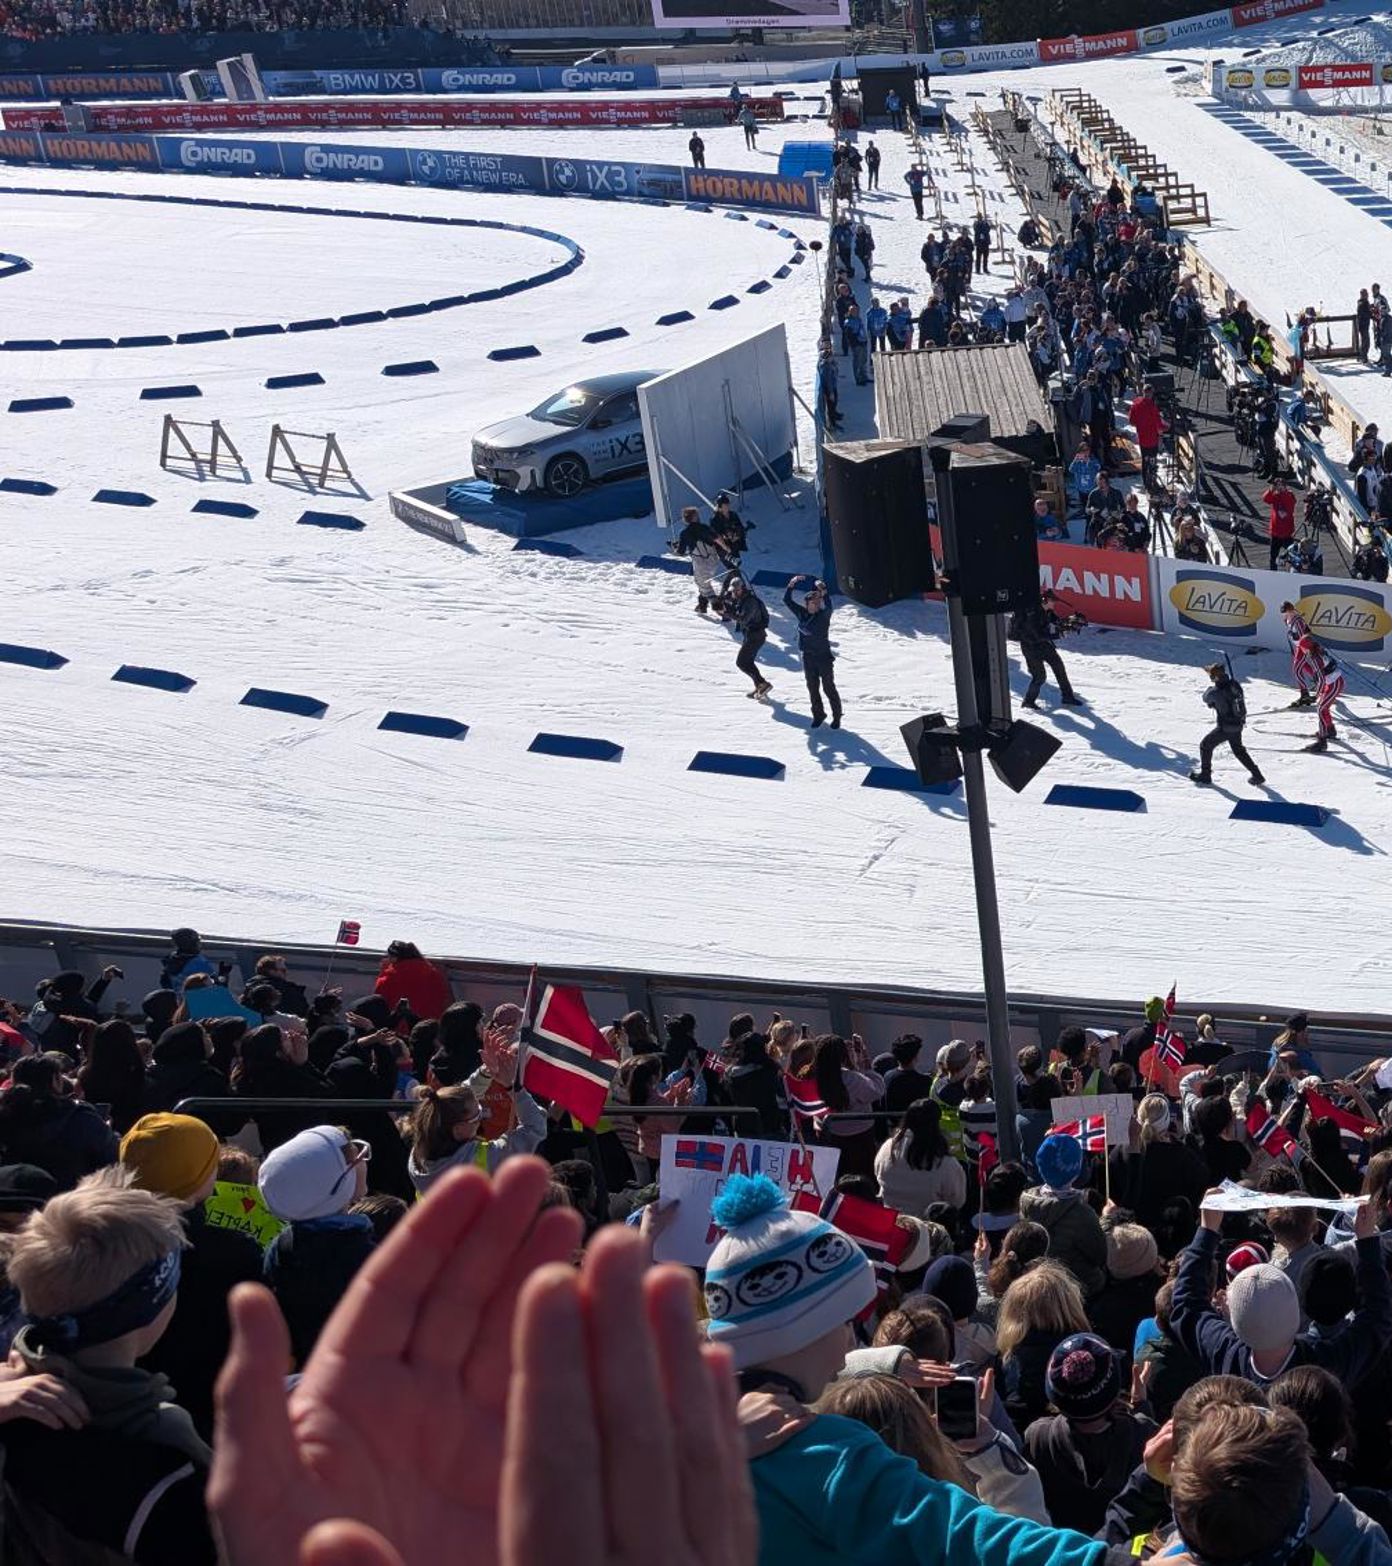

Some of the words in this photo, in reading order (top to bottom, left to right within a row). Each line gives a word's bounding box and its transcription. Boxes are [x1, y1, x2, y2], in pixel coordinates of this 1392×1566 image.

[1170, 16, 1229, 37] LAVITA.COM
[971, 48, 1034, 62] LAVITA.COM
[1049, 37, 1128, 59] VIESSMANN
[329, 73, 378, 90] BMW
[384, 73, 416, 89] iX3
[441, 70, 516, 88] CONRAD
[561, 69, 635, 86] CONRAD
[1301, 67, 1371, 86] VIESSMANN
[161, 111, 228, 129] VIESSMANN
[237, 110, 302, 126] VIESSMANN
[308, 109, 372, 124] VIESSMANN
[380, 109, 444, 123] VIESSMANN
[452, 109, 515, 123] VIESSMANN
[520, 108, 581, 123] VIESSMANN
[589, 108, 649, 123] VIESSMANN
[180, 140, 256, 166] CONRAD
[304, 145, 384, 172] CONRAD
[443, 154, 467, 168] THE
[470, 156, 502, 170] FIRST
[445, 168, 462, 182] OF
[464, 170, 472, 183] A
[473, 171, 498, 185] NEW
[501, 172, 529, 187] ERA.
[586, 164, 628, 192] iX3
[689, 174, 807, 206] HÖRMANN
